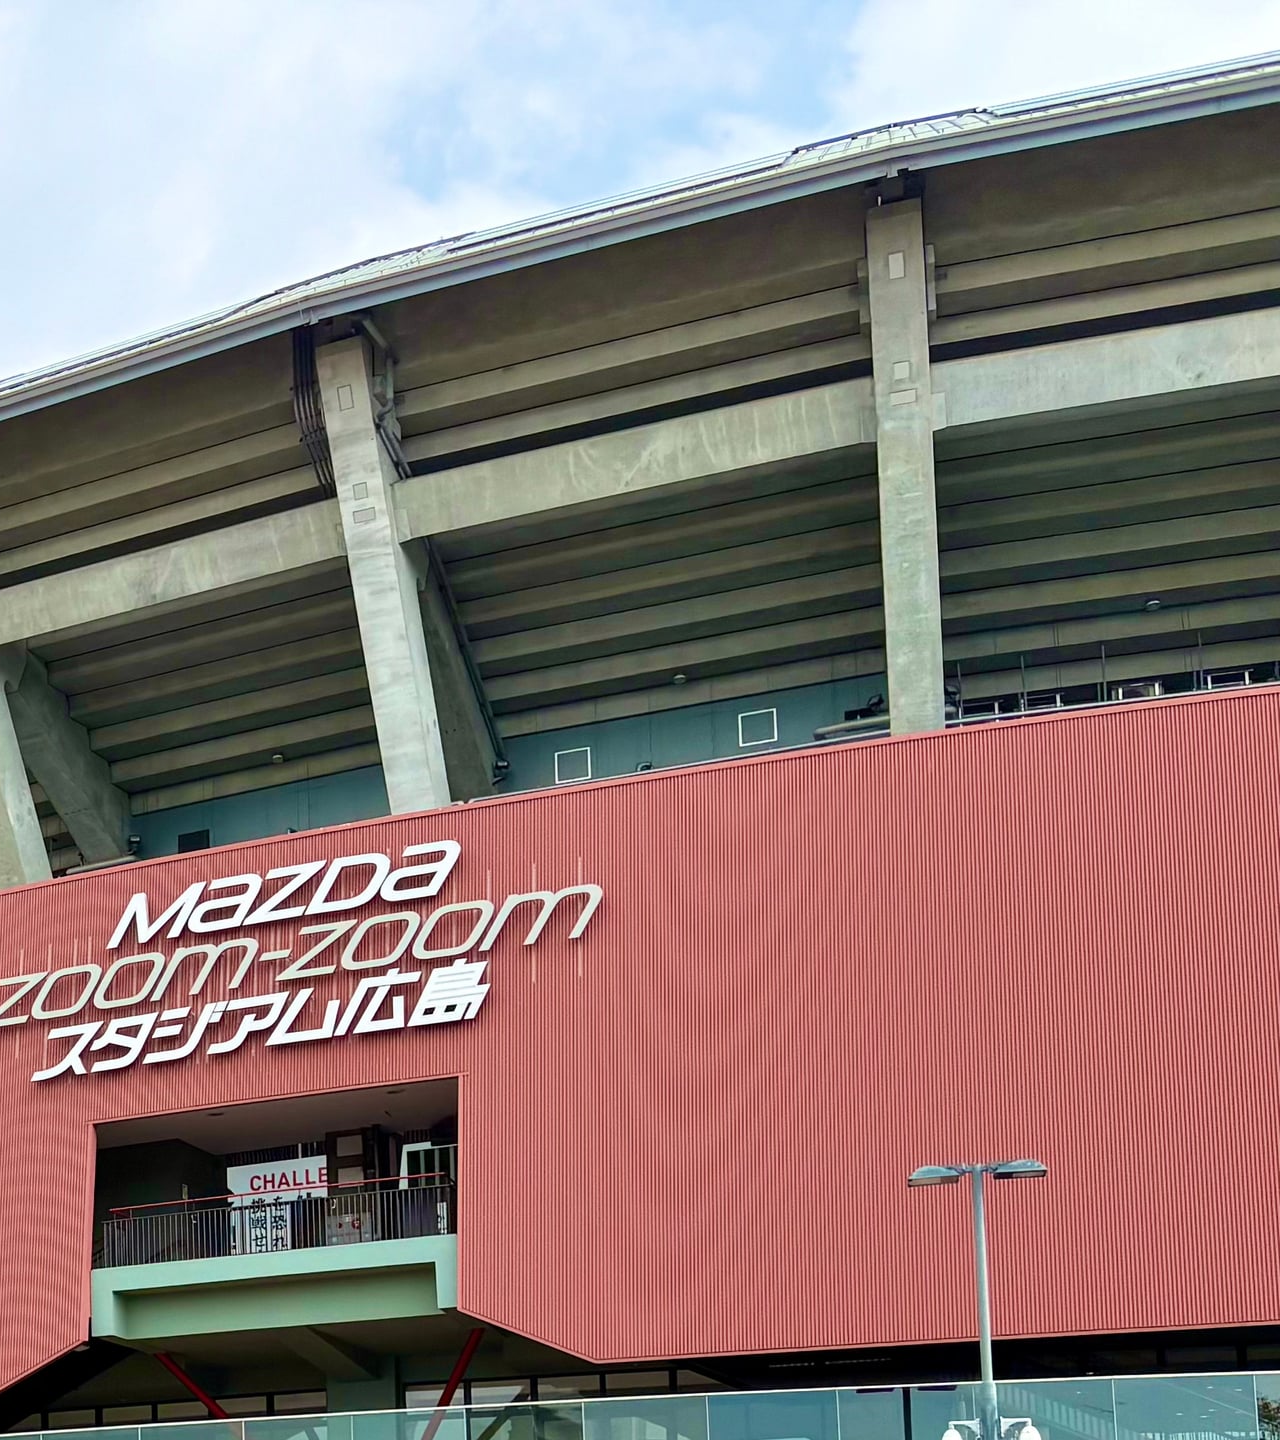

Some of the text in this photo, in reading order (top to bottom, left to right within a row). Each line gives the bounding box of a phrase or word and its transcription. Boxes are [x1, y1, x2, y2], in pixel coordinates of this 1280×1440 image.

[30, 959, 491, 1082] スタジアム広島
